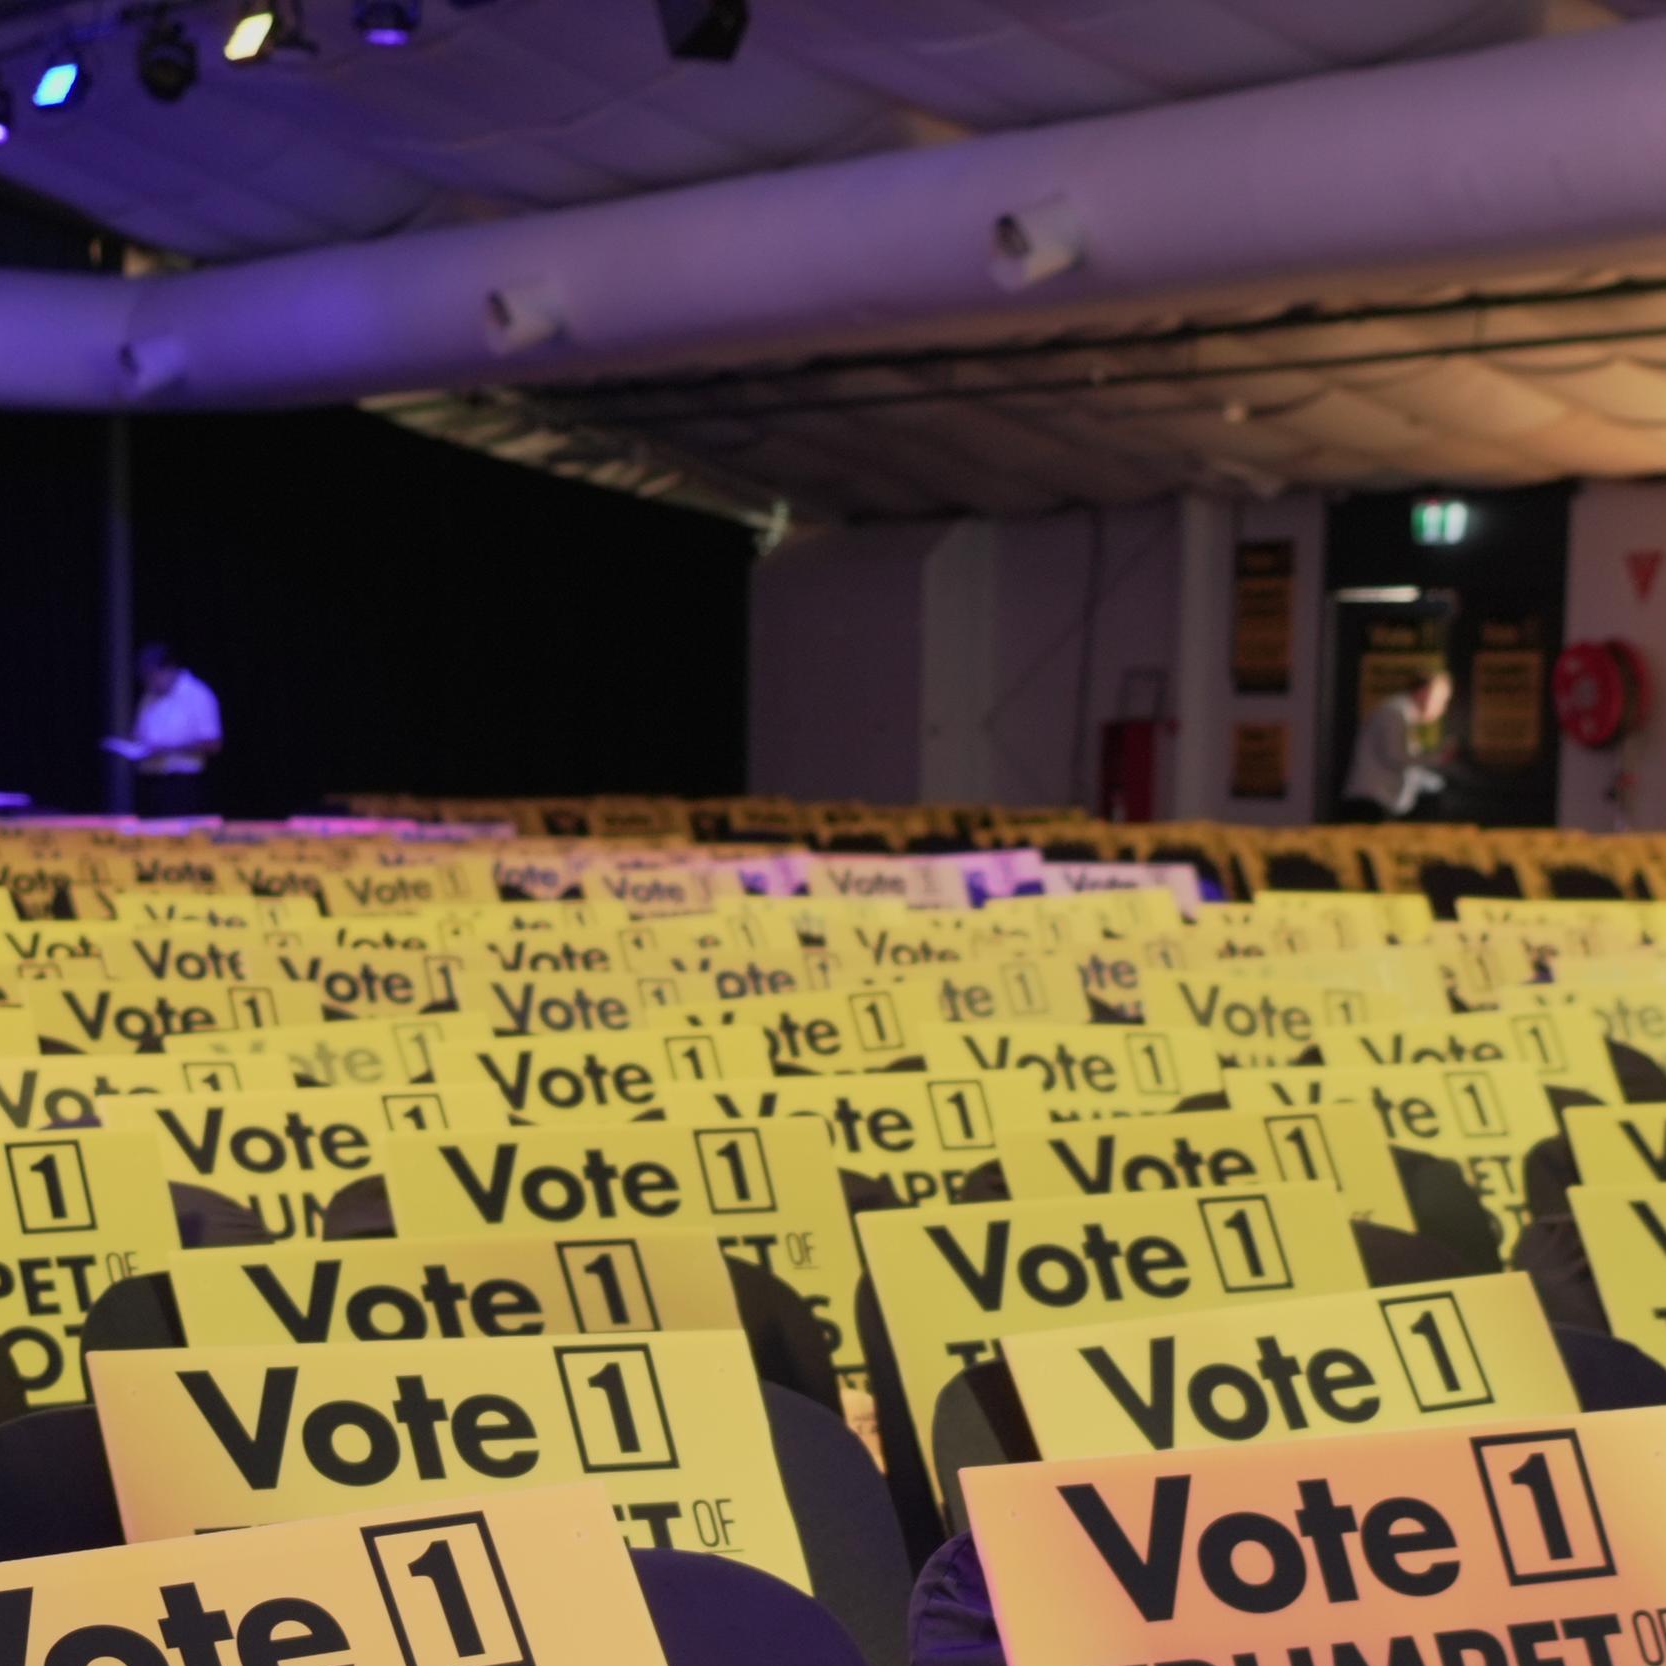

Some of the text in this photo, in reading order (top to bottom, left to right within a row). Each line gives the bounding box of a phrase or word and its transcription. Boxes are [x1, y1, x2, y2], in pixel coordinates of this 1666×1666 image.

[62, 990, 214, 1041] Vote
[492, 982, 631, 1034] Vote
[1179, 982, 1311, 1041] Vote
[477, 1051, 655, 1110] Vote
[156, 1107, 371, 1174] Vote
[1049, 1136, 1257, 1195] Vote
[438, 1142, 681, 1224] Vote
[924, 1219, 1191, 1311] Vote
[241, 1259, 544, 1344] Vote
[1079, 1335, 1380, 1451] Vote
[175, 1366, 539, 1490] Vote
[692, 1499, 734, 1548] OF
[1058, 1475, 1460, 1622] Vote
